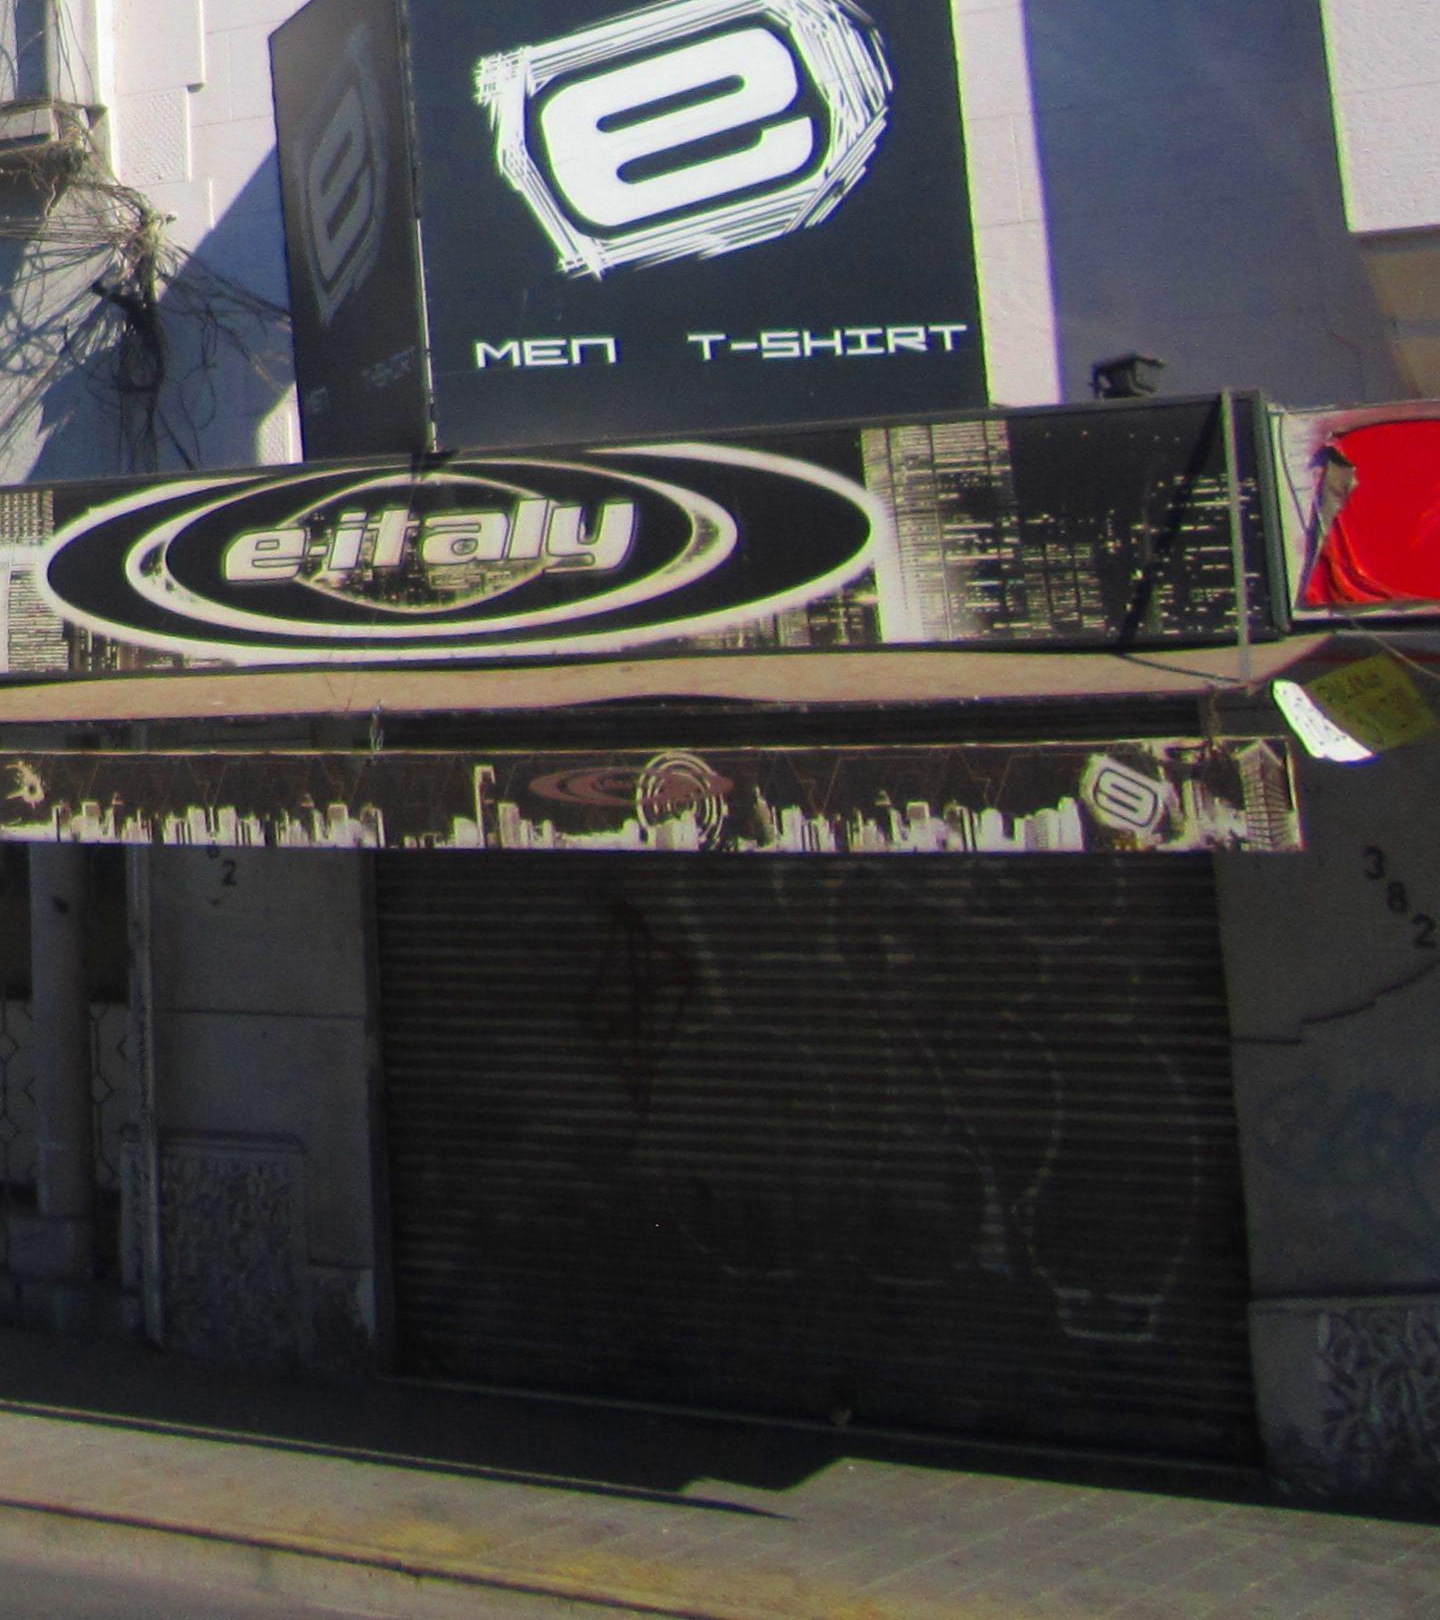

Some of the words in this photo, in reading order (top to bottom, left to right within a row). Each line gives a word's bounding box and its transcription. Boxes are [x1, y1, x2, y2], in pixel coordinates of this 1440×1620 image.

[475, 335, 617, 369] MEN
[687, 324, 969, 361] T-SHIRT
[226, 497, 636, 581] e-italy
